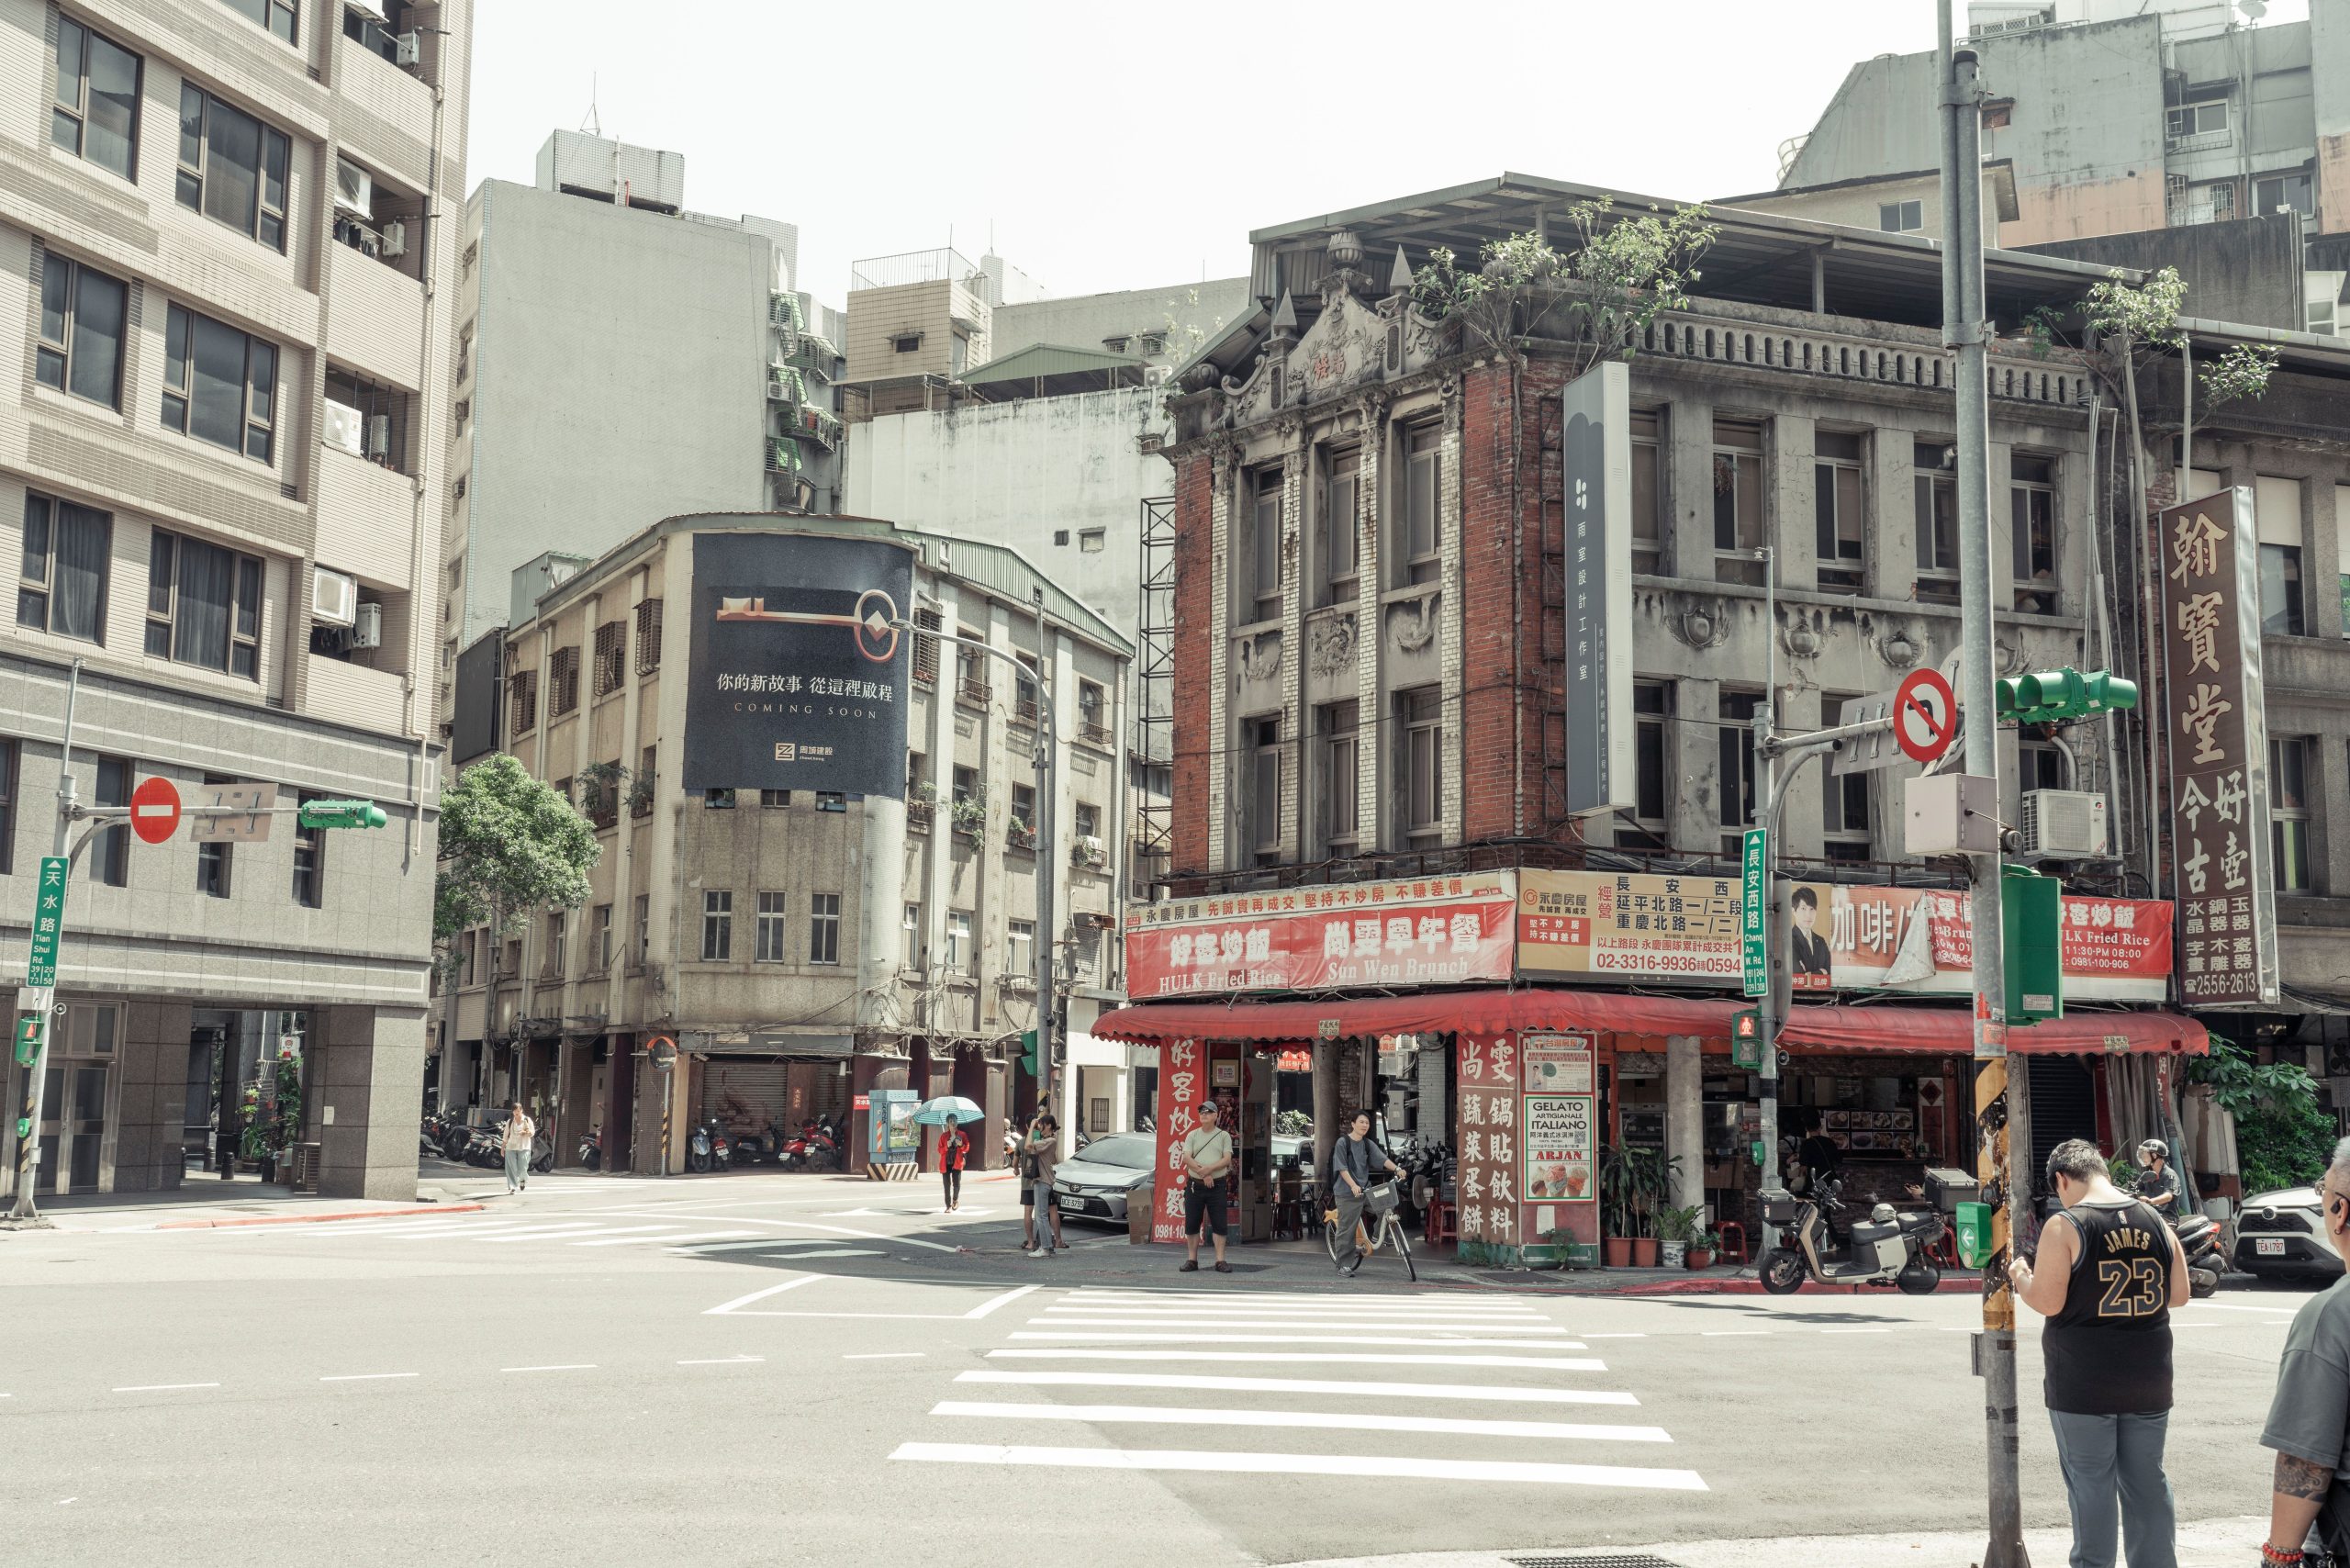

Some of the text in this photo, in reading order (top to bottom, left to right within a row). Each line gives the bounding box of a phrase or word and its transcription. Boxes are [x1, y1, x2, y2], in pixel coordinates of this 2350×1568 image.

[2170, 511, 2232, 765] 翰寶堂
[717, 673, 802, 693] 你的新故事
[734, 702, 877, 719] COMING SOON
[1747, 848, 1760, 929] 長安西路
[39, 871, 61, 933] 天水路
[1147, 904, 1199, 924] 永慶房屋
[1207, 895, 1294, 917] 先誠實再成交
[1304, 887, 1384, 909] 堅持不炒房
[1394, 879, 1462, 900] 不賺差價
[1539, 891, 1587, 907] 永慶房屋
[1597, 885, 1612, 919] 經營
[1617, 895, 1742, 916] 延平北路一/二段
[1539, 905, 1586, 915] 先誠實 再成交
[2186, 901, 2205, 935] 水晶
[2209, 899, 2228, 932] 銅器
[2231, 897, 2250, 931] 玉器
[1529, 919, 1538, 939] 堅持
[1539, 919, 1580, 930] 不炒房
[35, 934, 50, 943] Tian
[1324, 913, 1480, 960] 尚雯早午餐
[1539, 931, 1580, 944] 不賺差價
[1597, 936, 1639, 949] 以上路段
[1744, 933, 1763, 945] Chang
[2061, 929, 2151, 946] LK Fried Rice
[33, 945, 50, 954] Shui
[1169, 928, 1270, 968] 好客炒飯
[1745, 943, 1754, 954] An
[2112, 948, 2142, 958] 08:00
[2186, 941, 2205, 972] 字畫
[2210, 937, 2229, 971] 木雕
[2232, 936, 2252, 969] 瓷器
[32, 956, 44, 964] Rd.
[1328, 956, 1469, 980] Sun Wen Brunch
[1596, 953, 1741, 973] 02-3316-9936轉0594
[1745, 956, 1763, 965] W. Rd.
[29, 976, 39, 984] 73
[1158, 969, 1281, 993] HULK Fried Rice
[1746, 981, 1765, 992] 229 308
[2197, 972, 2256, 995] 2556-2613
[1461, 1038, 1516, 1083] 尚雯
[1532, 1102, 1583, 1112] GELATO
[1531, 1120, 1587, 1130] ITALIANO
[1461, 1093, 1485, 1235] 蔬菜蛋餅
[1536, 1150, 1583, 1160] ARJAN
[1488, 1096, 1516, 1240] 鍋貼飲料
[2104, 1227, 2151, 1253] JAMES
[2098, 1257, 2165, 1316] 23
